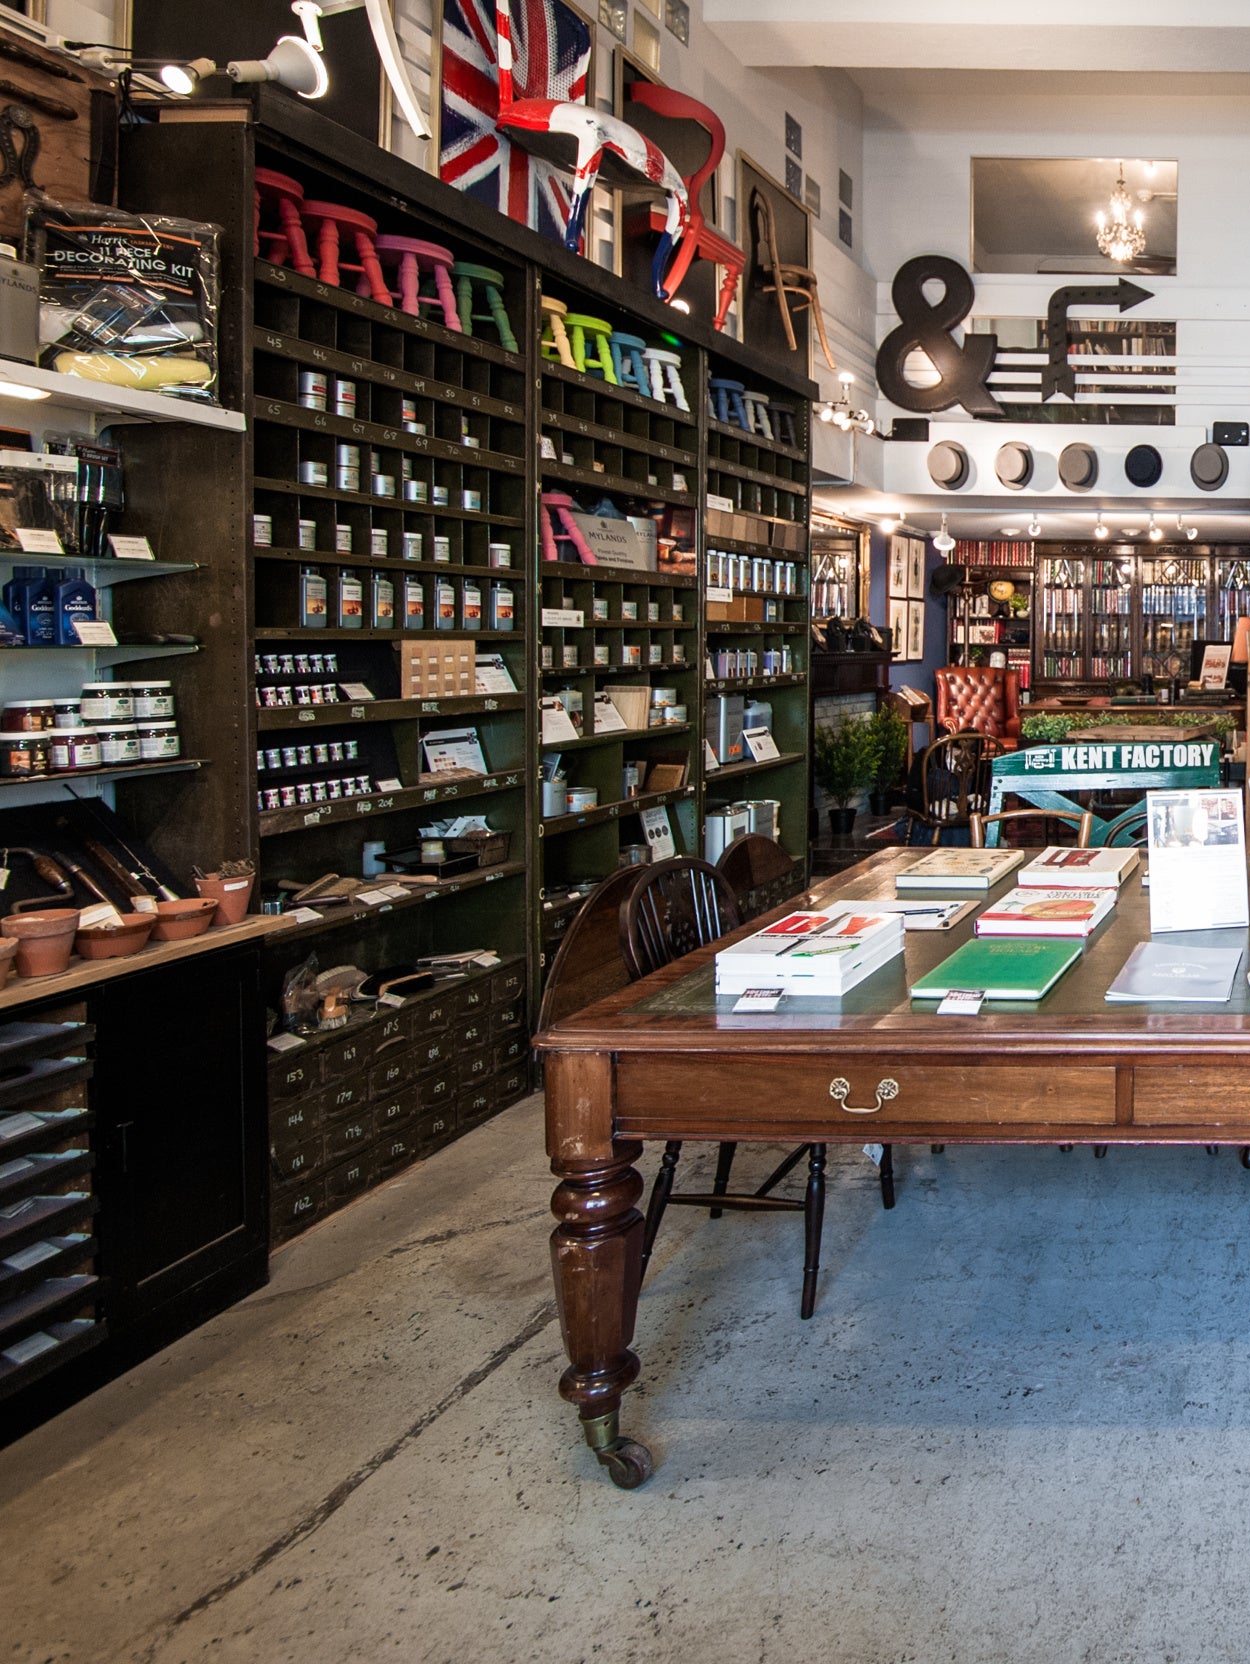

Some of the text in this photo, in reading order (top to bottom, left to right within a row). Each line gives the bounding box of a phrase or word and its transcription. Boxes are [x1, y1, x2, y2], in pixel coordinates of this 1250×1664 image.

[91, 234, 128, 247] Harris
[54, 250, 167, 271] DECORATING
[171, 264, 194, 278] KIT
[270, 268, 286, 282] 25
[0, 278, 38, 294] YLANDS
[316, 284, 329, 297] 26
[414, 318, 428, 332] 29
[266, 335, 283, 349] 45
[312, 349, 327, 362] 46
[504, 351, 517, 364] 32
[351, 360, 364, 373] 47
[414, 380, 426, 392] 49
[445, 389, 456, 399] 50
[472, 396, 481, 406] 51
[267, 404, 281, 415] 65
[504, 405, 516, 415] 52
[314, 415, 327, 427] 66
[548, 414, 558, 423] 39
[352, 424, 365, 435] 67
[383, 430, 398, 441] 68
[415, 437, 428, 449] 69
[473, 451, 482, 461] 71
[588, 531, 628, 544] MYLANDS
[1061, 744, 1214, 770] KENT FACTORY
[377, 797, 394, 808] 204
[317, 805, 332, 815] 203
[538, 824, 545, 839] D
[539, 952, 546, 968] B
[505, 976, 518, 987] 152
[429, 1009, 442, 1022] 184
[343, 1047, 356, 1060] 169
[286, 1069, 304, 1083] 153
[386, 1067, 400, 1081] 160
[433, 1081, 446, 1094] 157
[387, 1104, 400, 1117] 131
[287, 1110, 304, 1127] 146
[432, 1120, 445, 1133] 173
[391, 1142, 405, 1156] 172
[292, 1155, 304, 1169] 161
[293, 1196, 313, 1214] 162
